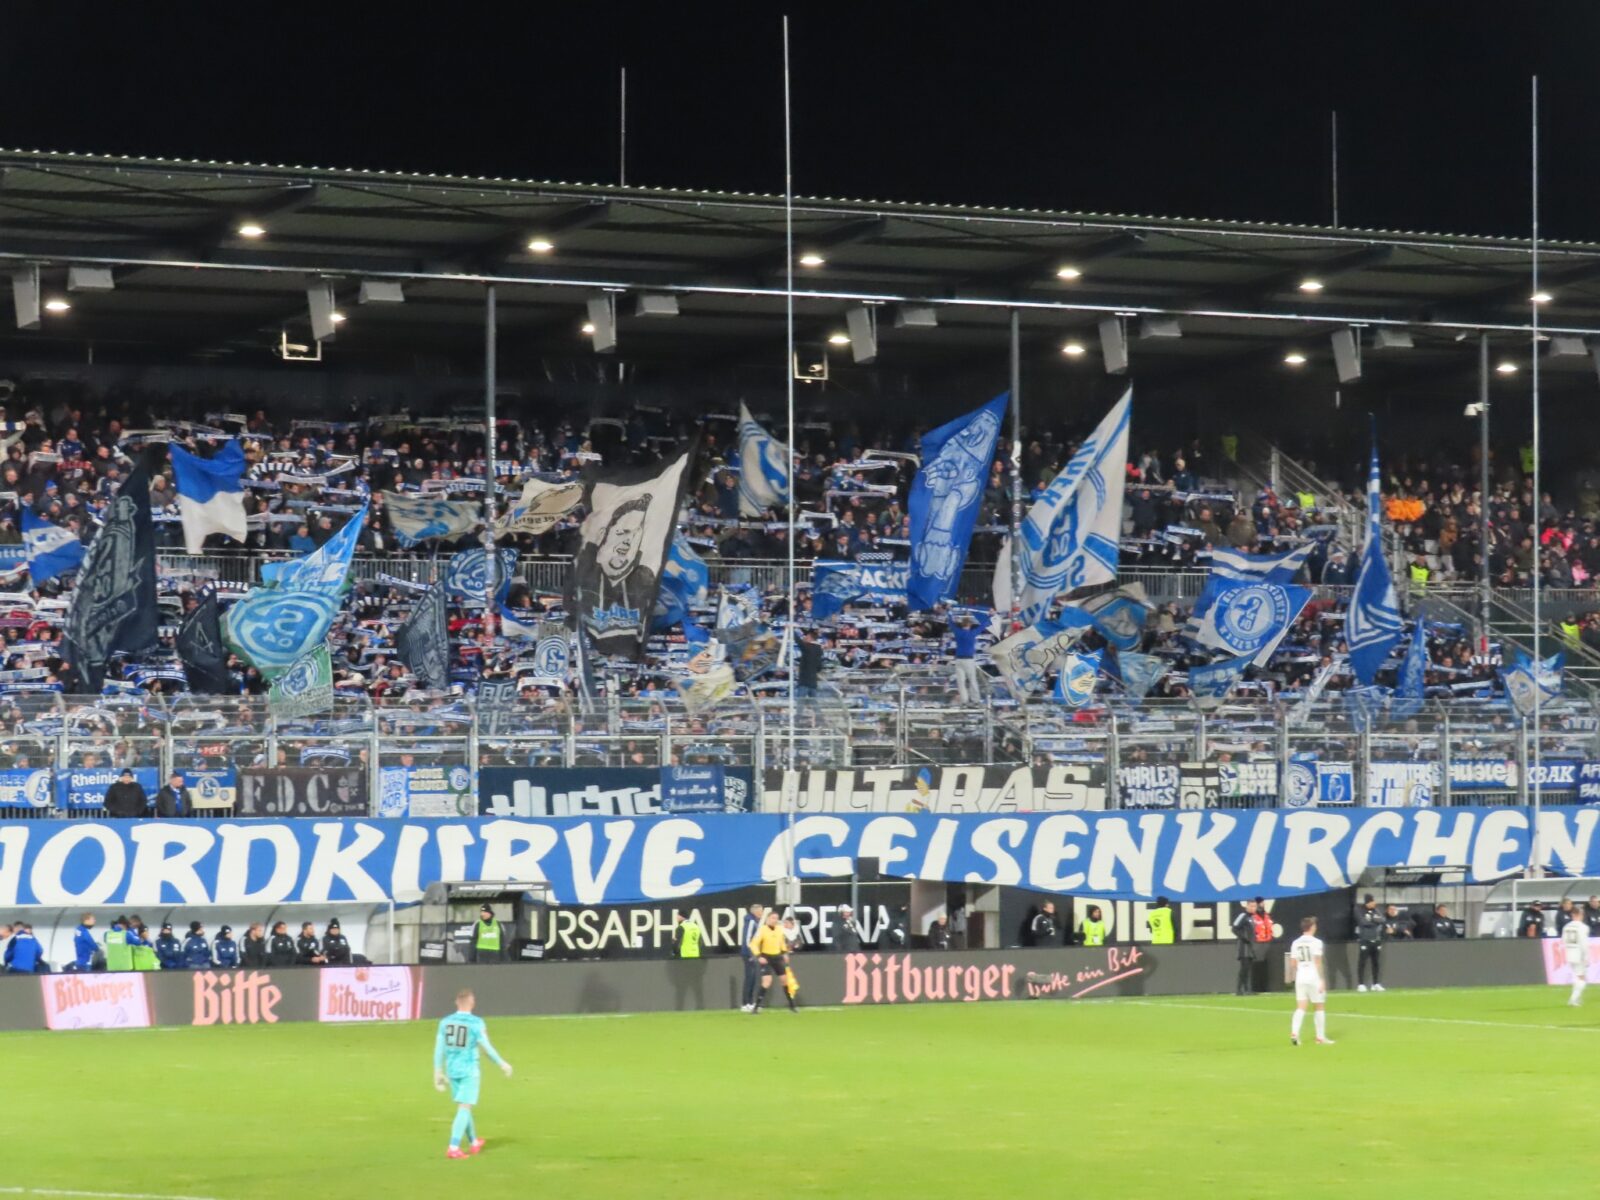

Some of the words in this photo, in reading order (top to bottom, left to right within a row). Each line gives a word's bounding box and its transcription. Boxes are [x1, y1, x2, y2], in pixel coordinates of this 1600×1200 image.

[1108, 946, 1143, 972] Bit
[54, 976, 133, 1014] Bitburger
[842, 953, 1016, 1003] Bitburger
[192, 970, 282, 1026] Bitte
[327, 984, 402, 1020] Bitburger
[445, 1024, 467, 1048] 20
